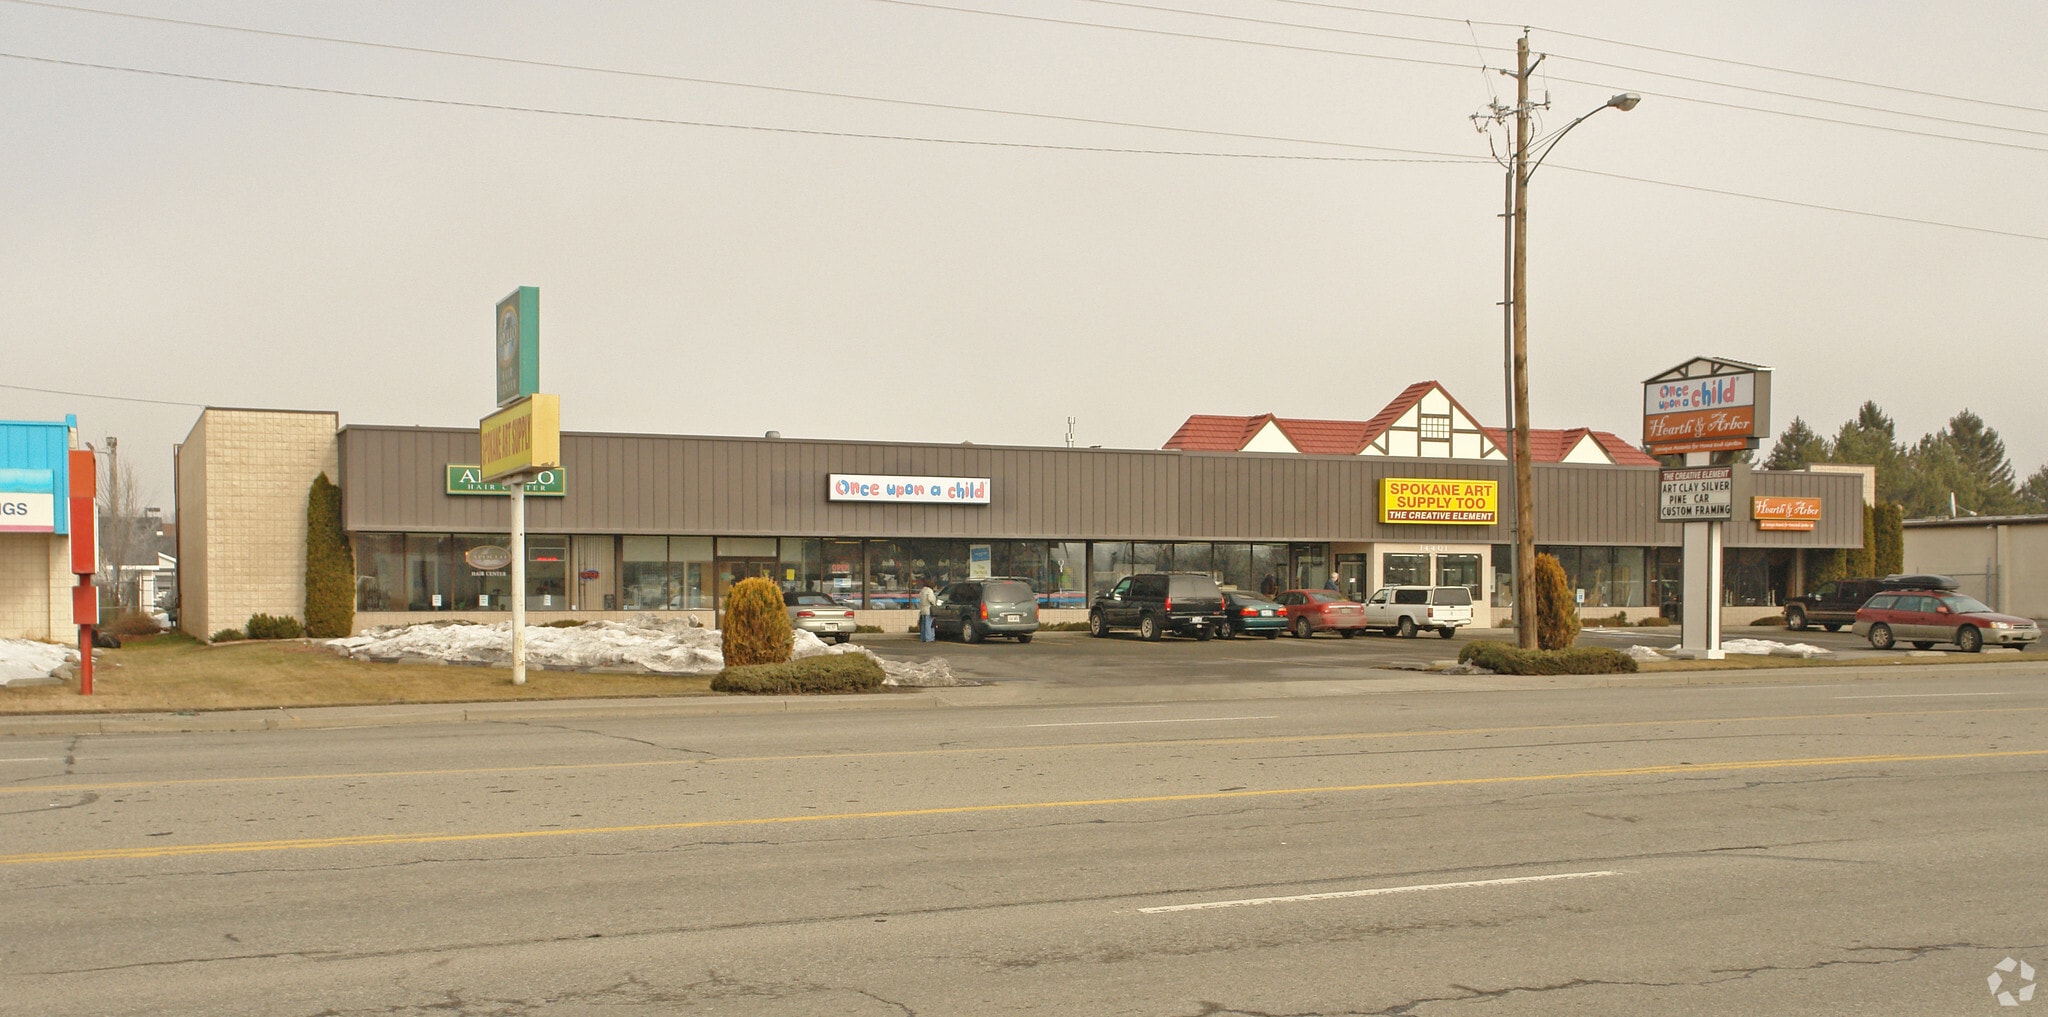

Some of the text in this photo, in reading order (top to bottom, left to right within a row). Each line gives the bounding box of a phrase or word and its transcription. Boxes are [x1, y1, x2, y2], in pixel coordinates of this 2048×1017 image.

[1660, 384, 1689, 398] Once
[1691, 376, 1736, 408] child
[1658, 398, 1689, 411] upon a
[1649, 411, 1750, 437] Hearth & Arbor
[1663, 470, 1729, 481] THE CREATIVE ELEMENT
[835, 479, 984, 499] Once upon a child
[1390, 483, 1492, 496] SPOKANE ART
[1663, 481, 1729, 493] ART CLAY SILVER
[1397, 496, 1486, 509] SUPPLY TOO
[1669, 494, 1709, 504] PINE CAR
[1662, 504, 1730, 516] CUSTOM FRAMING
[1756, 499, 1786, 514] Hearth
[1795, 501, 1819, 515] Arbor
[1389, 511, 1493, 520] THE CREATIVE ELEMENT
